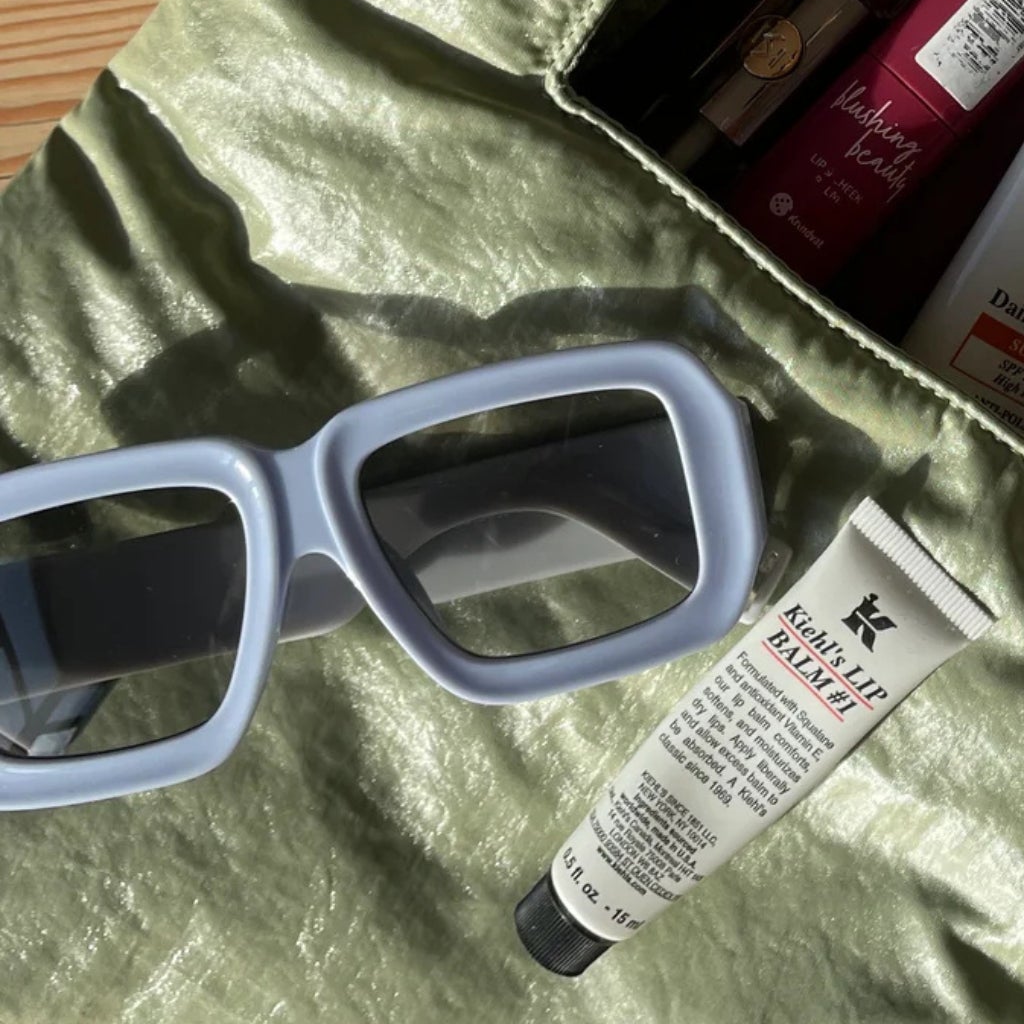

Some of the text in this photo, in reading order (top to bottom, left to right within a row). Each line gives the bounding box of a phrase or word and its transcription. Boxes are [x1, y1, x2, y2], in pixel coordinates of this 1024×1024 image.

[833, 79, 921, 157] blushing
[807, 151, 828, 172] LIP
[847, 127, 917, 204] beauty
[993, 373, 1020, 394] High
[998, 359, 1024, 376] SPF
[767, 628, 857, 714] BALM #1
[783, 604, 888, 701] Kiehl's LIP
[703, 687, 801, 783] softens, and moisturizes
[715, 675, 810, 773] our lip balm comforts,
[725, 664, 824, 762] and antioxidant Vitamin E,
[737, 651, 835, 750] Formulated with Squalane
[659, 733, 732, 807] classic since 1969.
[669, 719, 767, 817] be absorbed. A Kiehl's
[681, 710, 778, 805] and allow excess balm to
[692, 698, 791, 795] dry lips. Apply liberally
[633, 793, 670, 831] Ingredients
[669, 828, 698, 855] sourced
[638, 783, 658, 802] NEW
[655, 799, 677, 823] YORK,
[675, 818, 688, 831] NY
[642, 771, 668, 798] KIEHL'S
[665, 794, 690, 817] SINCE
[597, 846, 647, 896] www.kiehls.com
[651, 826, 670, 845] made
[563, 847, 577, 869] 0.5
[570, 866, 583, 885] fl.
[582, 883, 599, 904] oz.
[611, 909, 630, 924] 15
